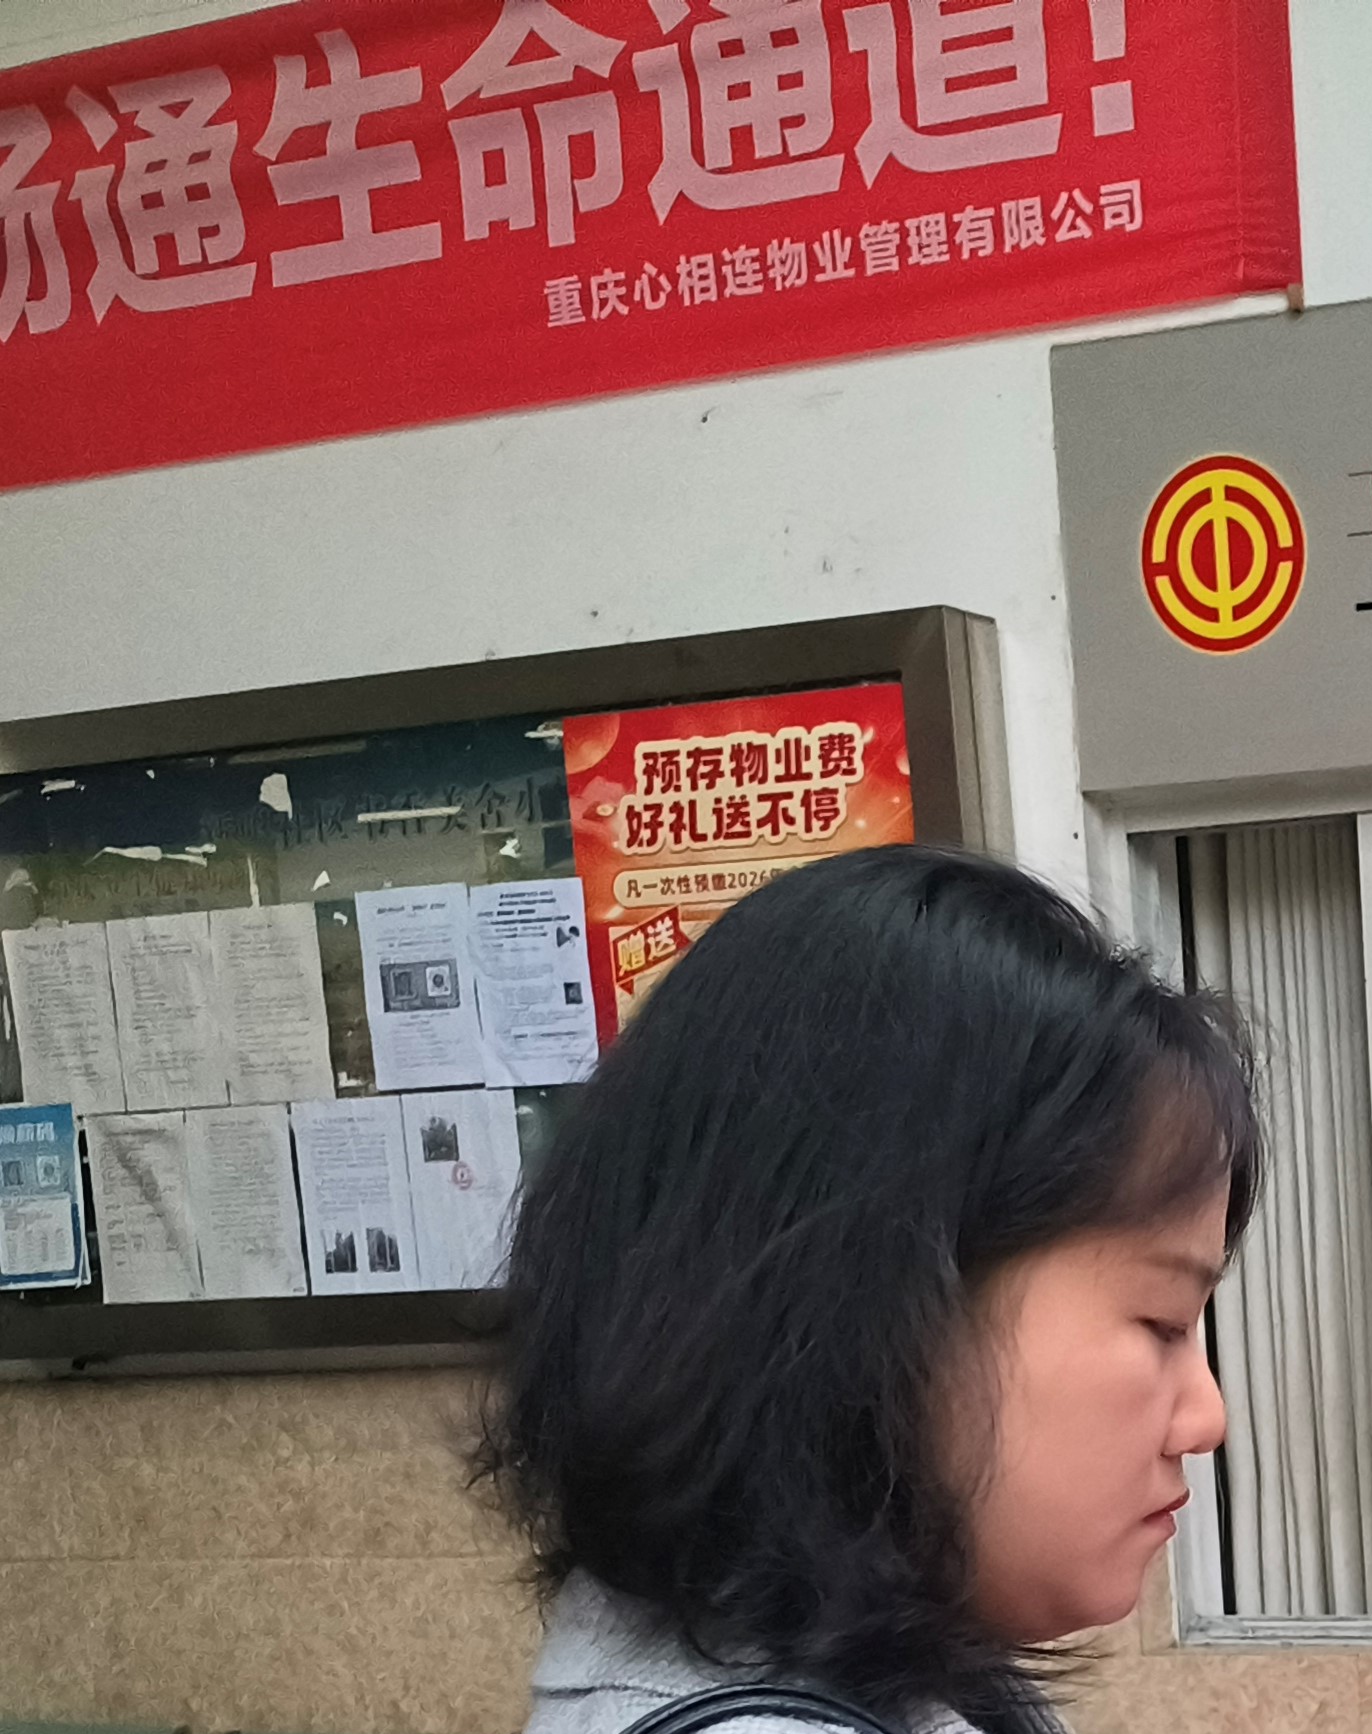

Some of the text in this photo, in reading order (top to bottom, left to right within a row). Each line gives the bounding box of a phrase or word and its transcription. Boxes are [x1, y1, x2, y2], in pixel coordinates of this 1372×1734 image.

[543, 178, 1144, 328] 重庆心相连物业管理有限公司
[641, 732, 858, 796] 预存物业费
[625, 786, 842, 848] 好礼送不停
[617, 915, 677, 976] 赠送
